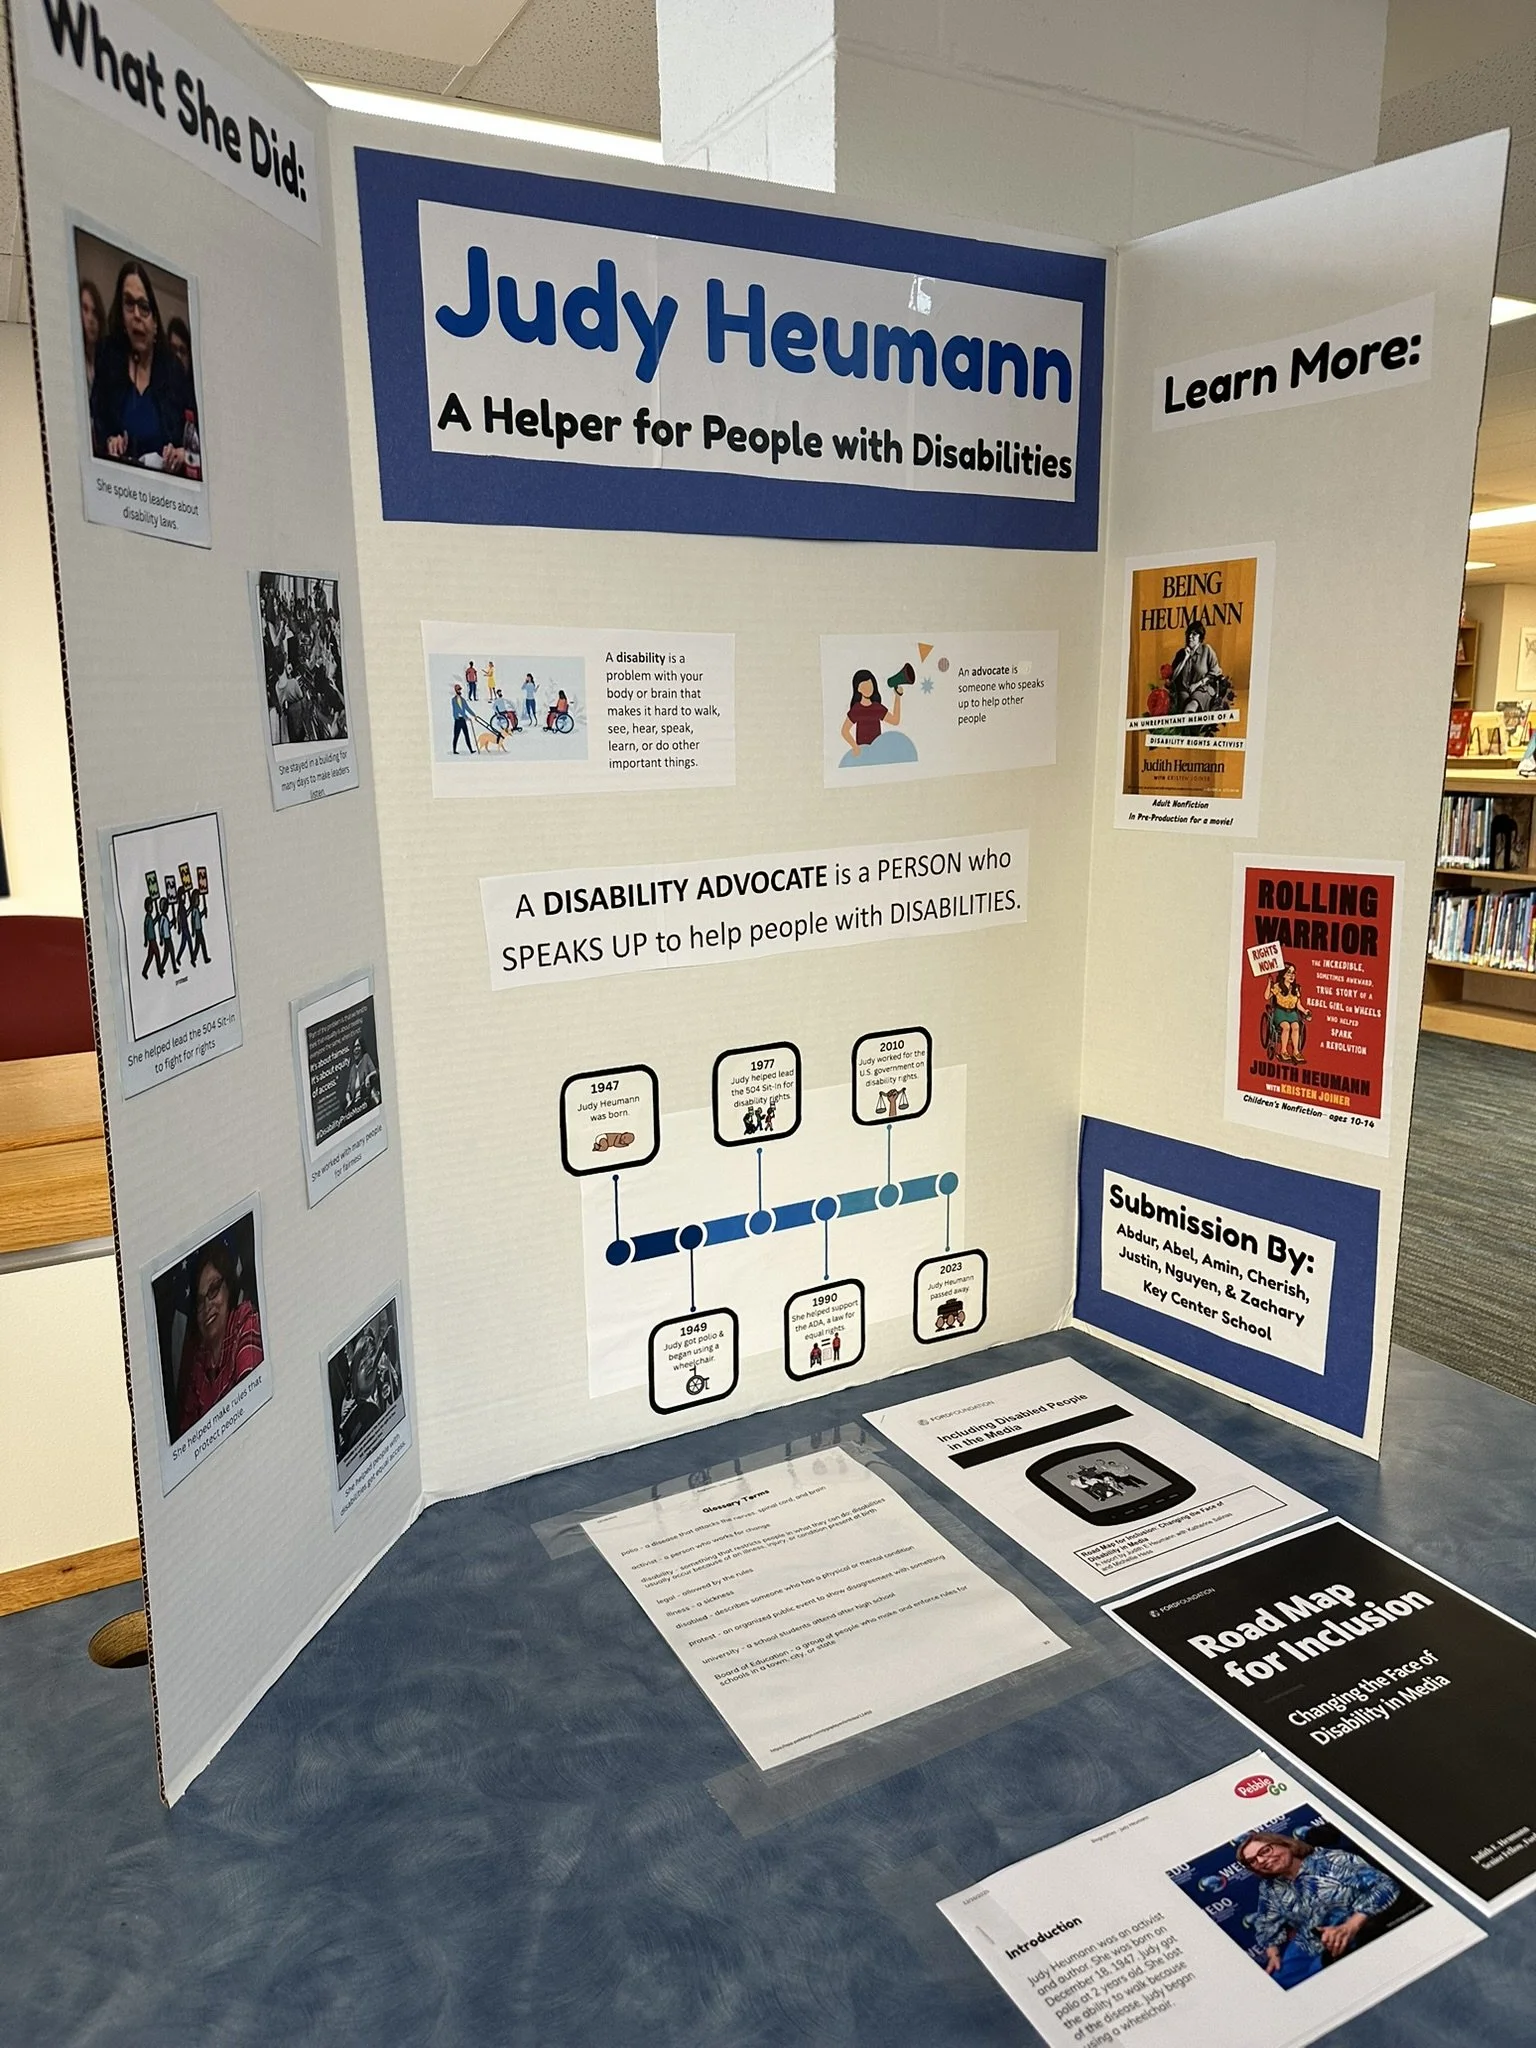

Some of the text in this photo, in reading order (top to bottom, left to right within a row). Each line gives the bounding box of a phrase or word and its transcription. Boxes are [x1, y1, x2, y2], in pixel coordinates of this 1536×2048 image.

[42, 0, 308, 202] What She Did:
[435, 246, 1072, 402] Judy Heumann
[1165, 334, 1421, 414] Learn More:
[438, 392, 1072, 479] A Helper for People with Disabilities
[1141, 570, 1243, 631] BEING HEUMANN
[606, 651, 685, 665] A disability is a
[606, 670, 703, 683] problem with your
[958, 665, 1018, 677] An advocate is
[607, 688, 701, 700] body or brain that
[958, 678, 1044, 693] someone who speaks
[608, 705, 720, 717] makes it hard to walk,
[959, 695, 1024, 710] up to help other
[608, 722, 693, 735] see, hear, speak,
[958, 713, 986, 725] people
[1141, 717, 1185, 726] UNREPENTANT
[609, 741, 638, 752] learn,
[656, 740, 669, 750] do
[672, 740, 700, 750] other
[609, 757, 698, 770] important things.
[1141, 759, 1224, 772] Judith Heumann
[1152, 799, 1209, 808] Adult Nonfiction
[1137, 813, 1187, 823] Pre-Production
[1189, 816, 1201, 824] for
[516, 848, 1012, 918] A DISABILITY ADVOCATE is a PERSON who
[1254, 879, 1379, 957] ROLLING WARRIOR
[502, 889, 1021, 972] SPEAKS UP to help people with DISABILITIES.
[1251, 944, 1279, 972] RIGHTS NOW!
[128, 1053, 143, 1066] She
[145, 1041, 170, 1059] helped
[173, 1033, 188, 1048] lead
[190, 1029, 201, 1040] the
[203, 1020, 216, 1034] 504
[879, 1039, 905, 1052] 2010
[155, 1040, 216, 1073] to fight for rights
[751, 1059, 775, 1071] 1977
[591, 1080, 619, 1094] 1947
[1250, 1061, 1370, 1096] JUDITH HEUMANN
[577, 1096, 640, 1112] Judy Heumann
[1281, 1084, 1316, 1099] KRISTEN
[1319, 1095, 1350, 1106] JOINER
[590, 1113, 606, 1121] was
[1243, 1095, 1279, 1109] Children's
[1329, 1112, 1347, 1122] ages
[1351, 1117, 1374, 1128] 10-14
[1110, 1184, 1314, 1275] Submission By:
[940, 1262, 962, 1274] 2023
[1117, 1224, 1309, 1304] Abdur, Abel, Amin, Cherish,
[1119, 1247, 1305, 1327] Justin, Nguyen, & Zachary
[812, 1293, 838, 1306] 1990
[1143, 1280, 1272, 1340] Key Center School
[680, 1322, 707, 1336] 1949
[937, 1393, 1088, 1442] Including Disabled People
[947, 1424, 1022, 1451] in the Media
[702, 1490, 769, 1513] Glossary Terms
[1187, 1583, 1357, 1659] Road Map
[1223, 1589, 1434, 1687] for Inclusion
[1288, 1649, 1439, 1726] Changing the Face of
[1310, 1674, 1451, 1746] Disability in Media
[1238, 1778, 1271, 1796] Pebble
[1005, 1917, 1082, 1960] Introduction
